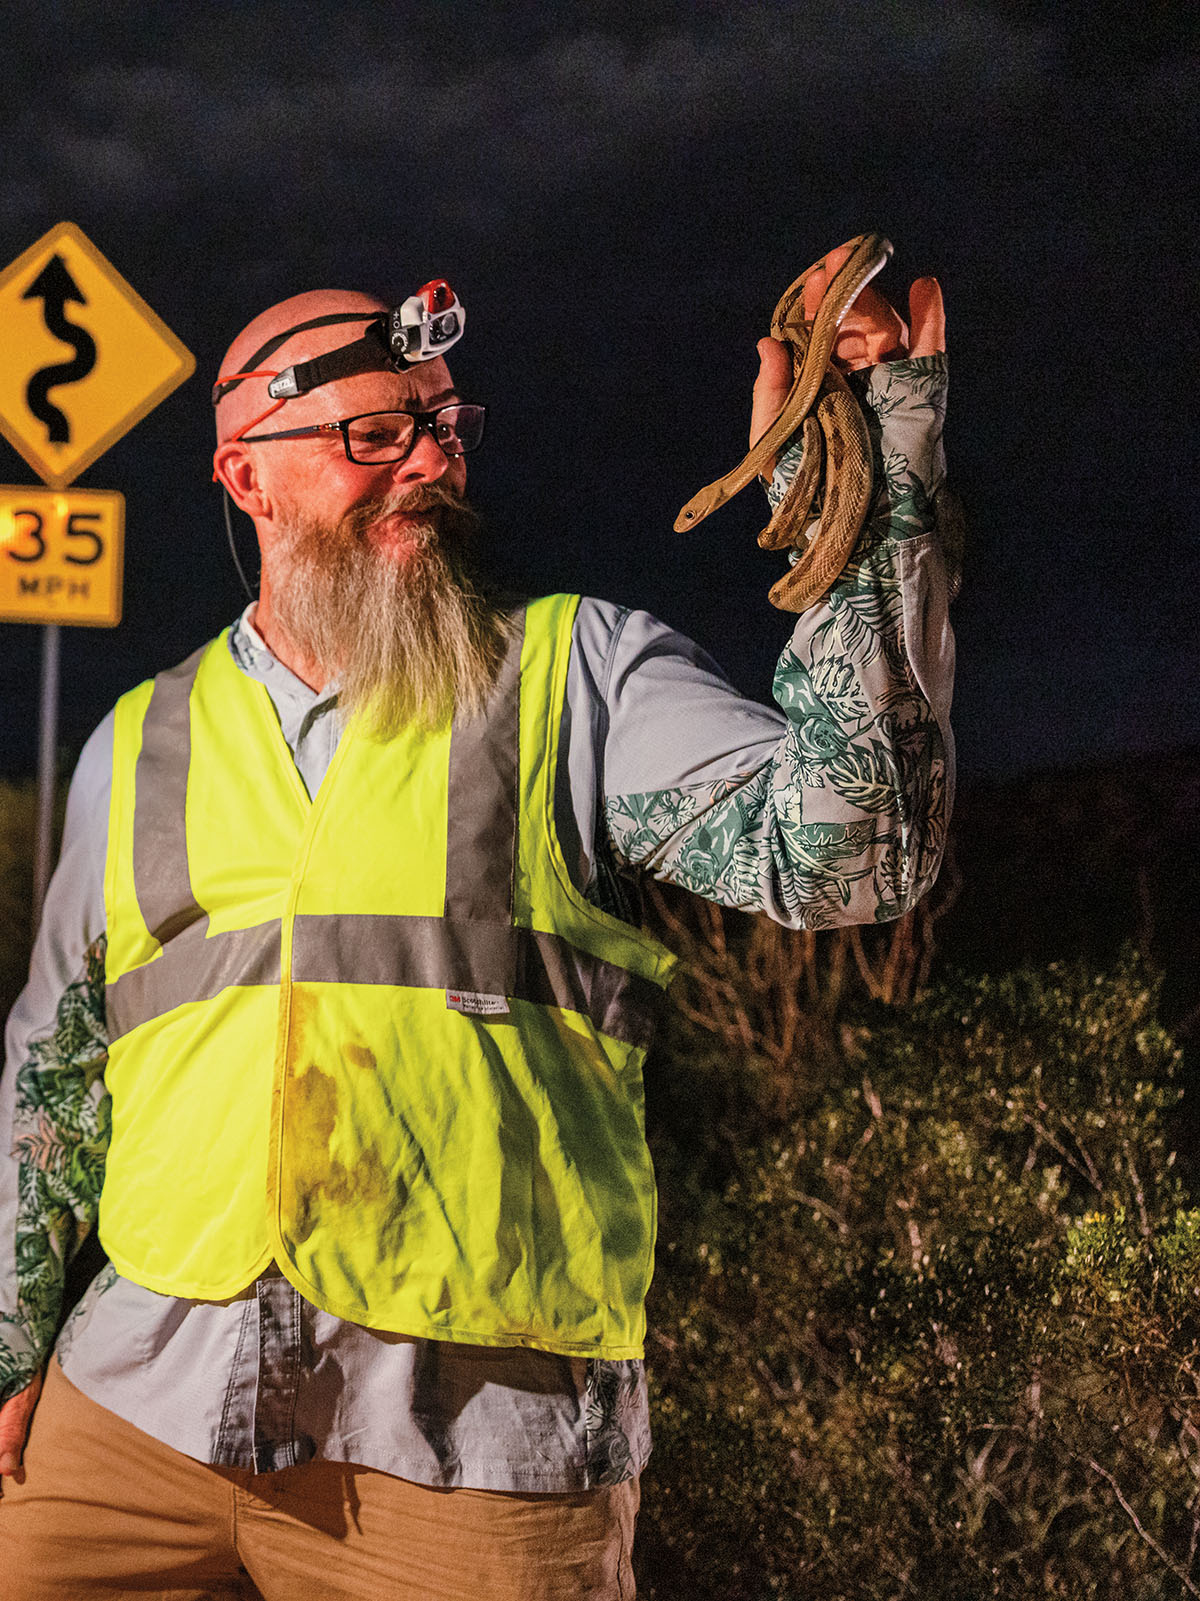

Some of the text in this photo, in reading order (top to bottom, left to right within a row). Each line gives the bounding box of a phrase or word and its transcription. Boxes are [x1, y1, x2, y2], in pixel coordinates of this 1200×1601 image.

[7, 510, 103, 565] 35
[19, 575, 90, 598] MPH
[449, 995, 461, 1003] 3M
